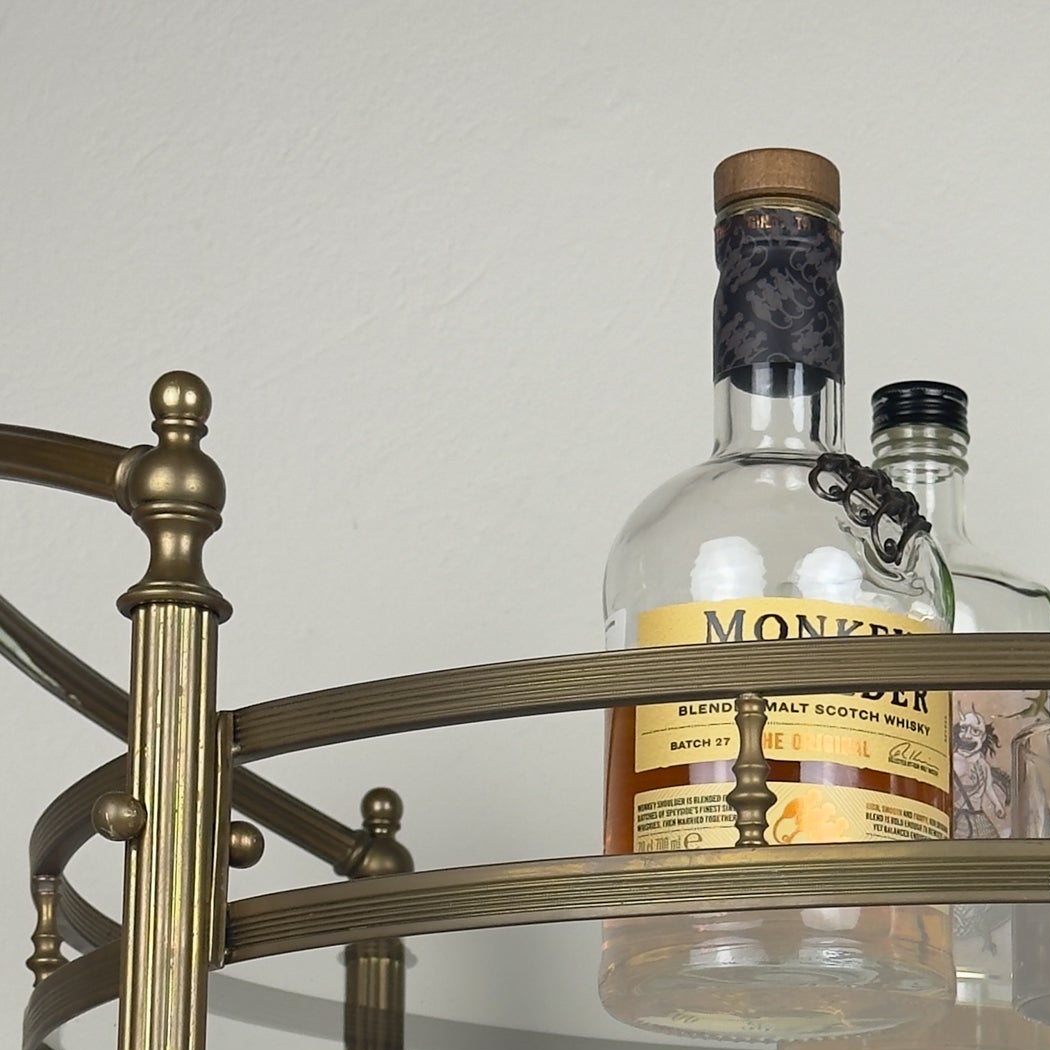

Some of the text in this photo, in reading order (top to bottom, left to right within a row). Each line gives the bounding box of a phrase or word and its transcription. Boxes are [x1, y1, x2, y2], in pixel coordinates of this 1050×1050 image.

[815, 704, 880, 722] SCOTCH
[884, 713, 931, 737] WHISKY
[670, 737, 731, 751] BATCH 27
[763, 732, 784, 750] HE
